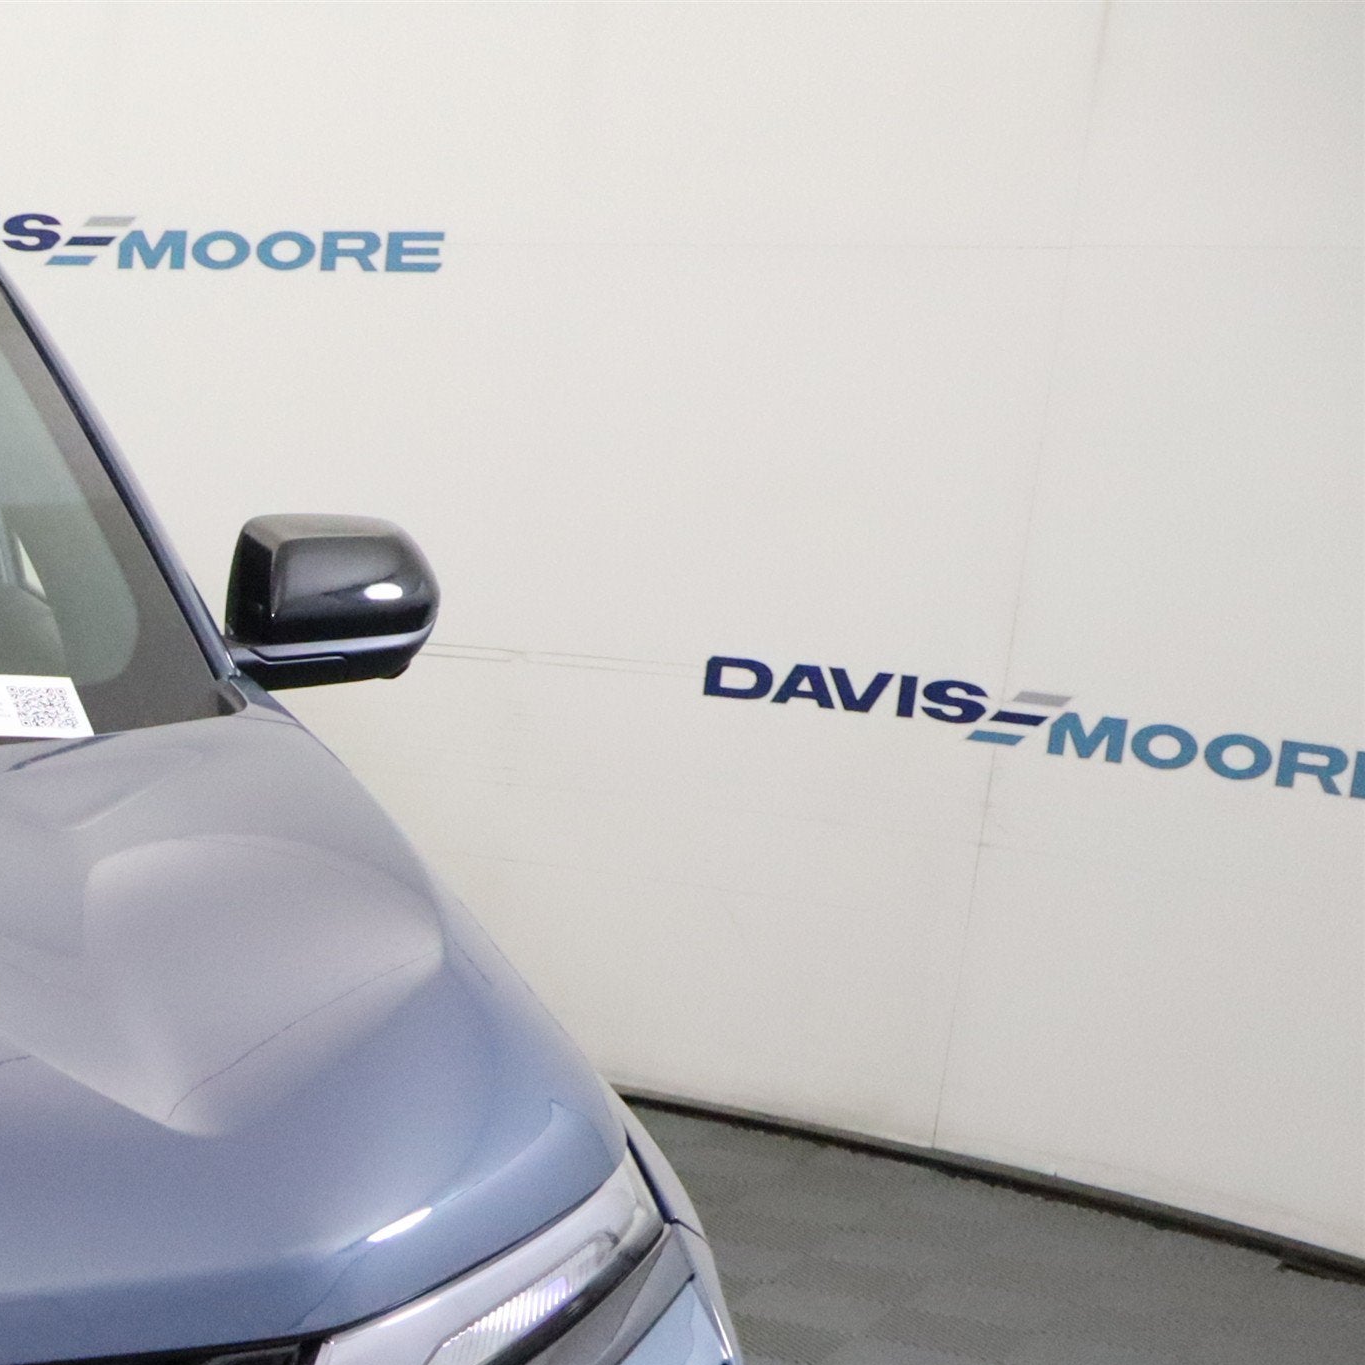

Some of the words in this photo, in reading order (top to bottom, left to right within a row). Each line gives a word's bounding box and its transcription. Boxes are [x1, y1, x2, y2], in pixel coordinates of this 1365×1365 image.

[117, 229, 445, 274] MOORE
[703, 655, 989, 724] DAVIS
[1046, 711, 1365, 800] MOOR
